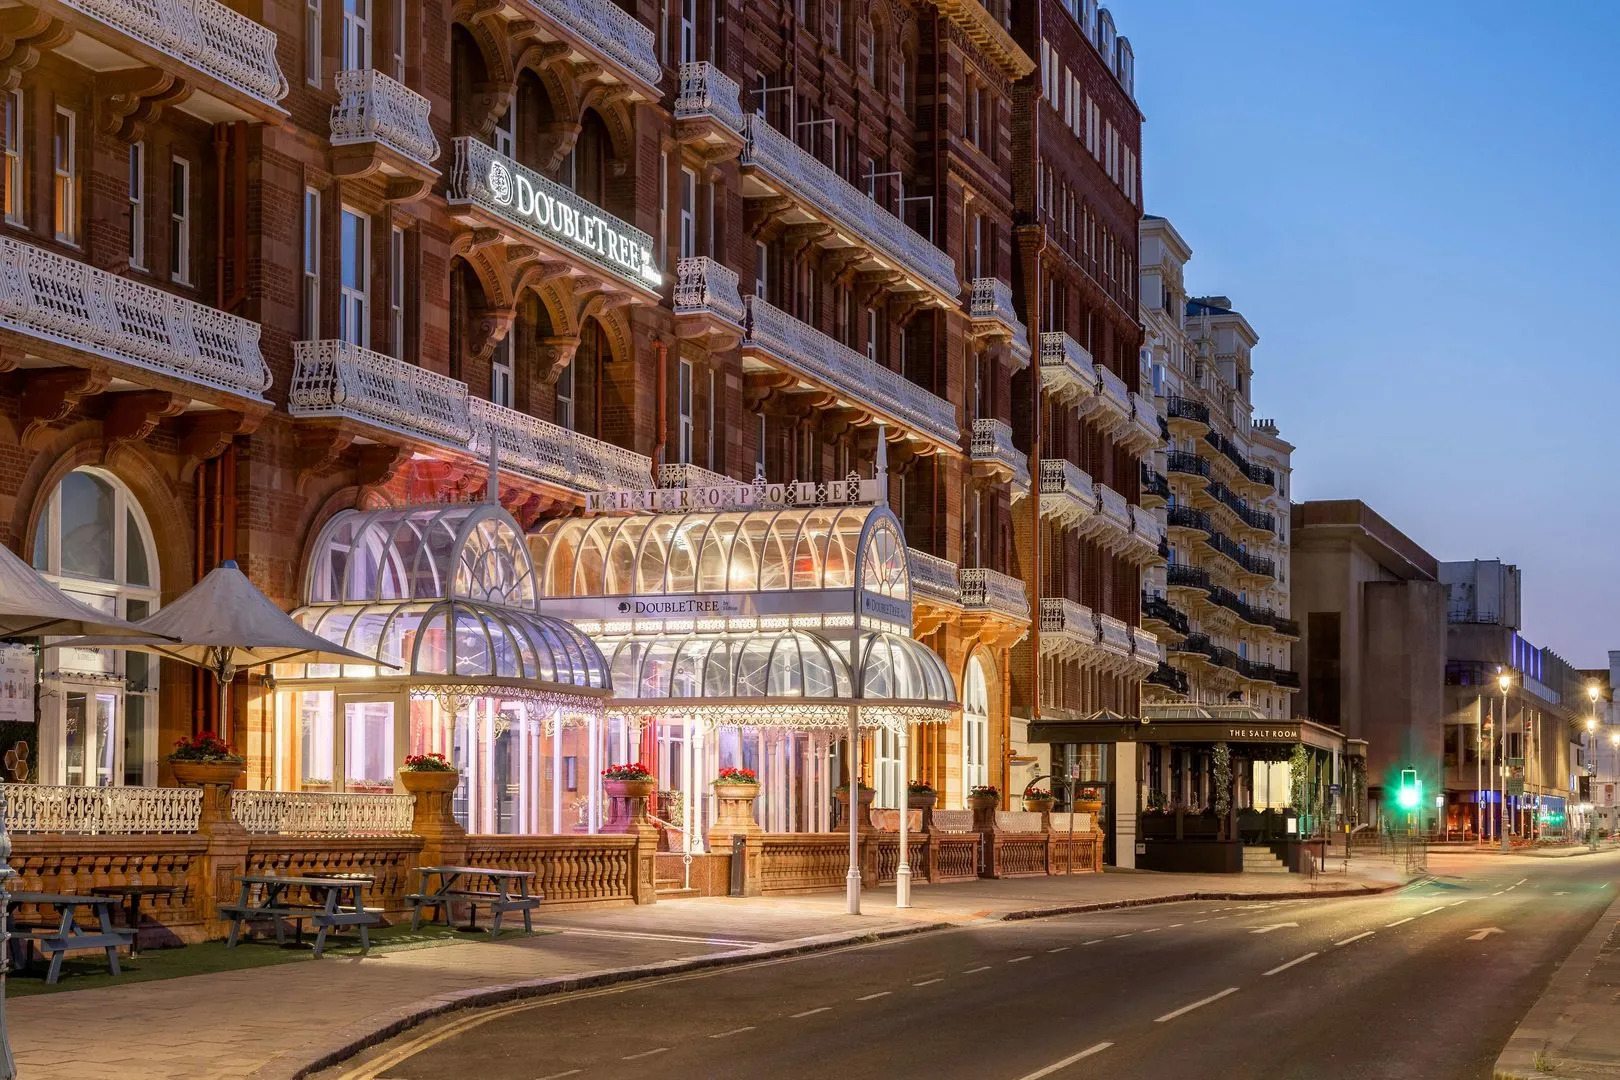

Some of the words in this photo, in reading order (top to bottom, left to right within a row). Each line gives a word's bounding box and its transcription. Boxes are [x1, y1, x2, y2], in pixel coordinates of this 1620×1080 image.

[589, 483, 842, 510] METROPOLE
[1229, 729, 1246, 737] THE
[1249, 729, 1270, 737] SALT
